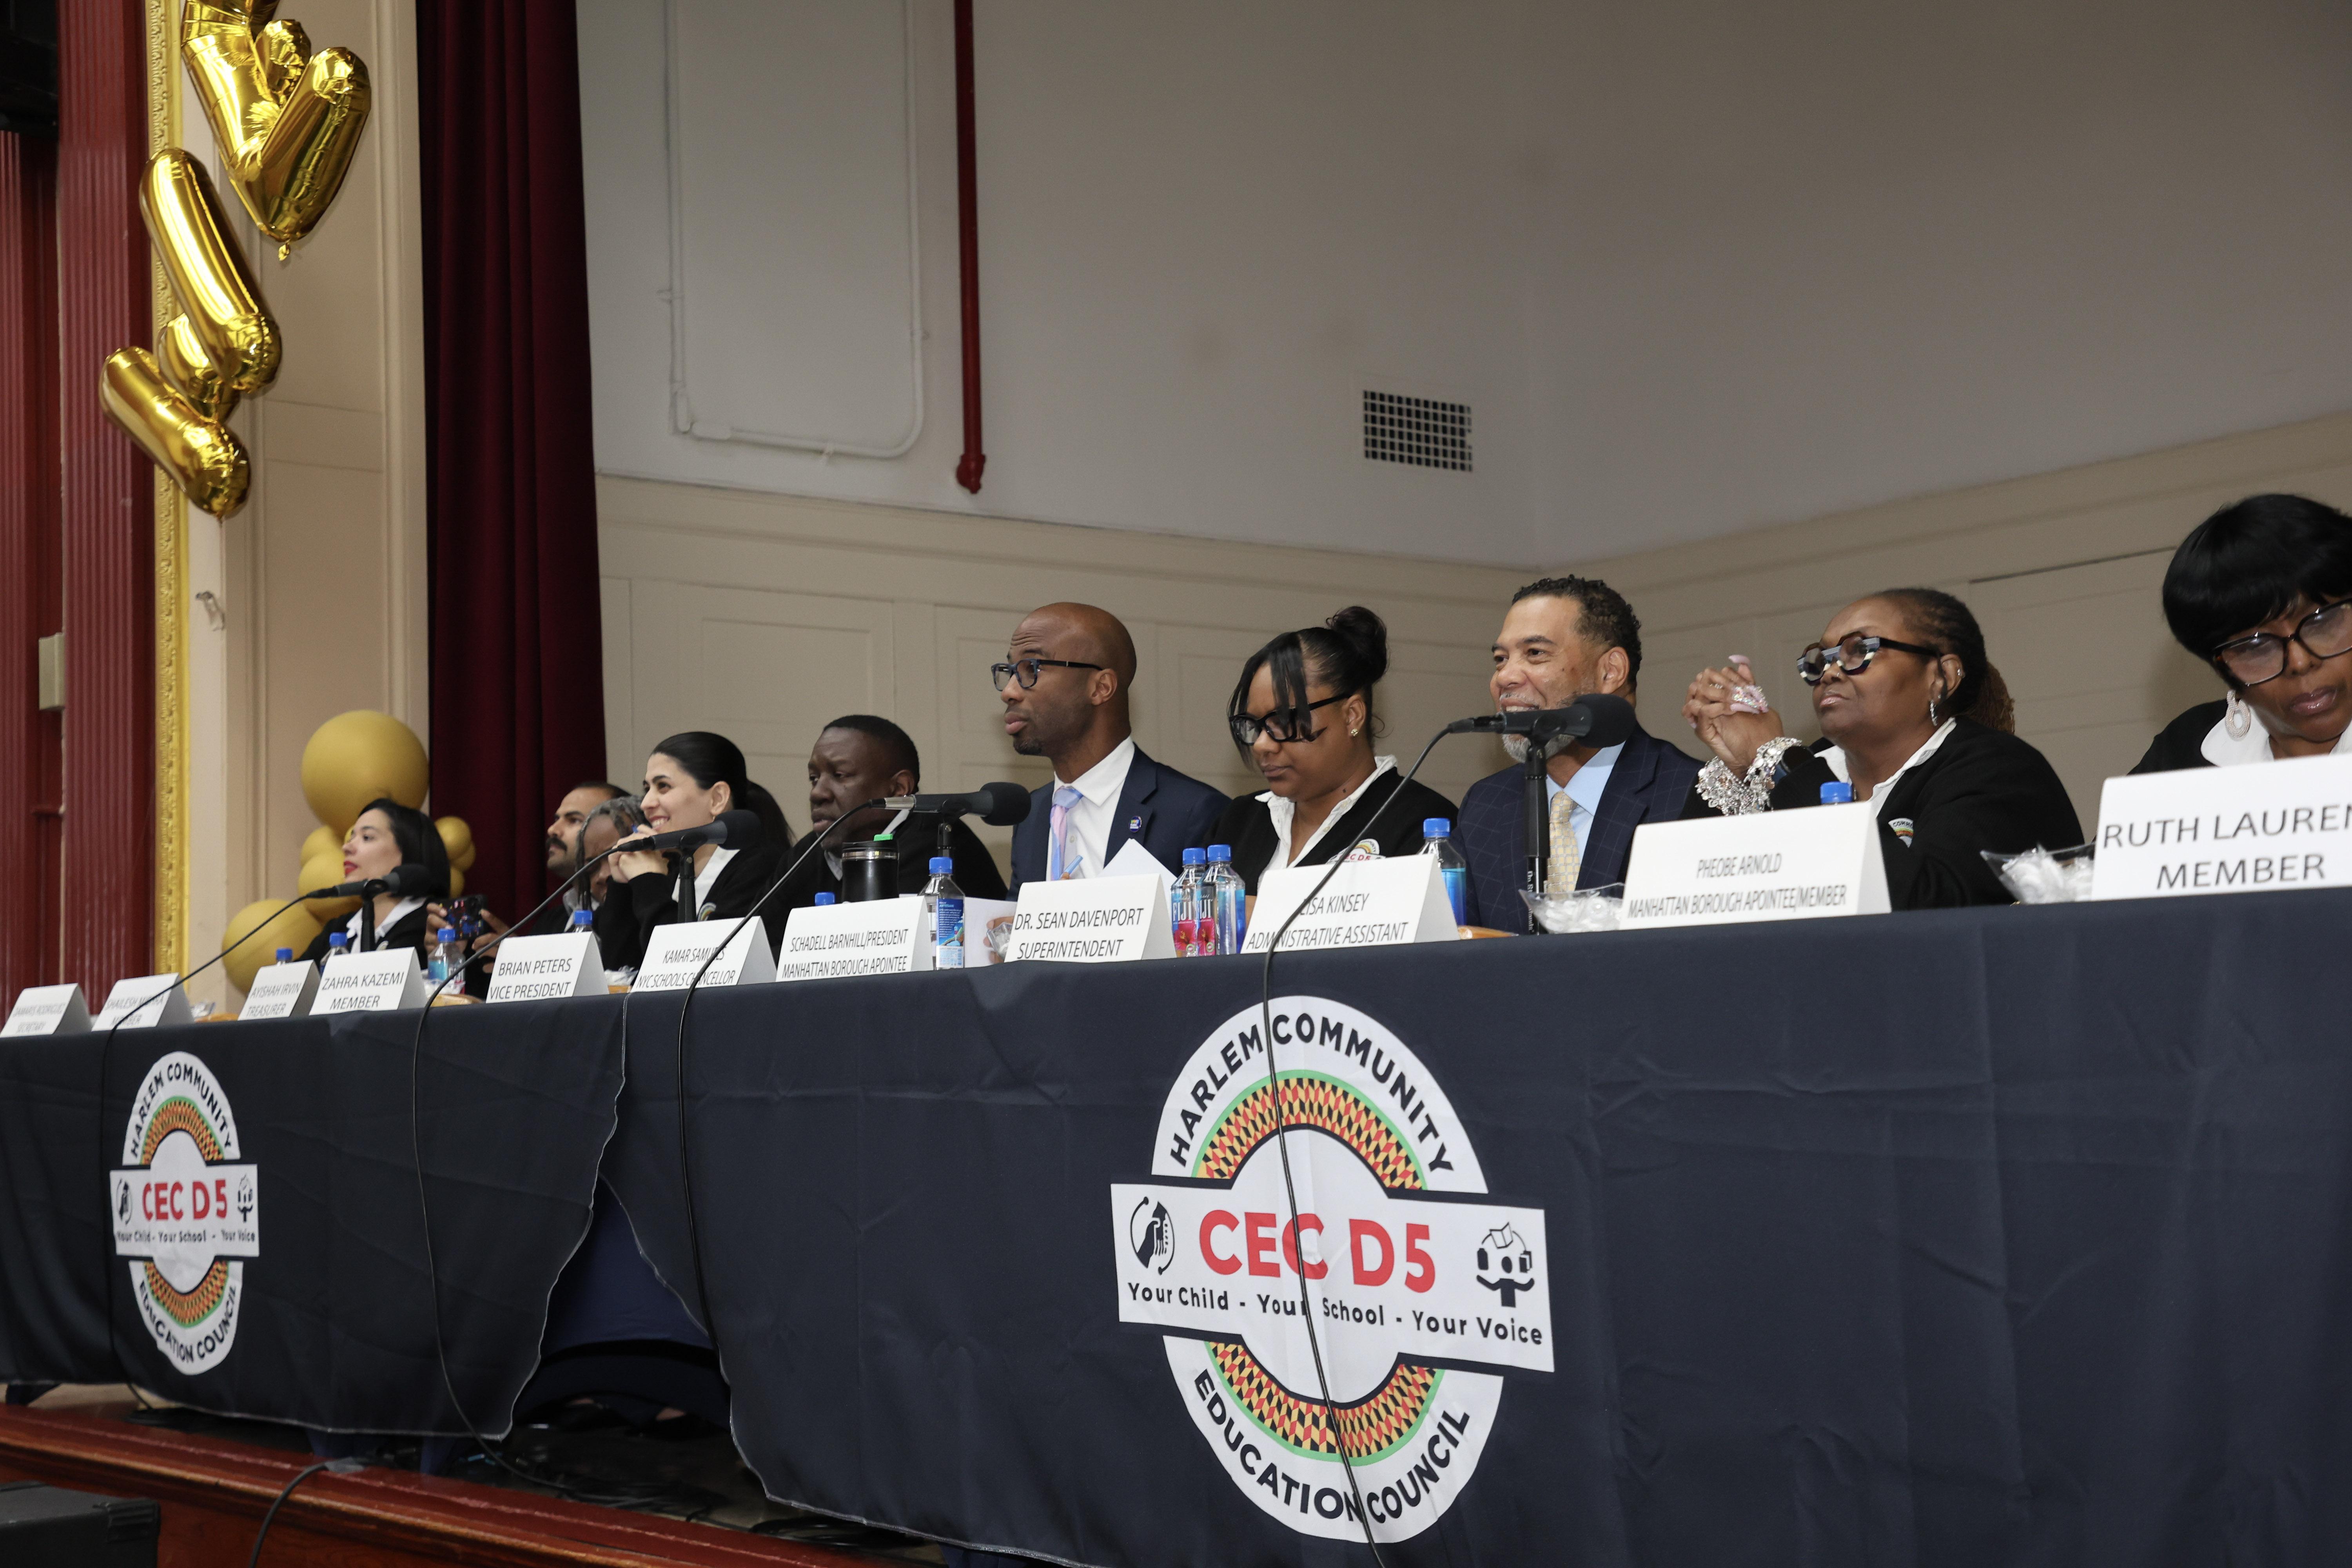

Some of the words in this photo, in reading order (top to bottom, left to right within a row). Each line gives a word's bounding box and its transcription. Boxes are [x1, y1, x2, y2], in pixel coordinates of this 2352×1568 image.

[2103, 817, 2200, 849] RUTH
[1697, 857, 1738, 878] PHEOBE
[1739, 853, 1782, 875] ARNOLD
[2156, 853, 2326, 890] MEMBER
[1326, 893, 1370, 915] KINSEY
[1628, 897, 1688, 918] MANHATTAN
[1691, 891, 1742, 914] BOROUGH
[1014, 914, 1033, 930] DR.
[1036, 912, 1068, 929] SEAN
[1069, 908, 1144, 928] DAVENPORT
[790, 935, 826, 952] SCHADELL
[1246, 926, 1343, 949] ADMNISTRATIVE
[1343, 922, 1408, 944] ASSISTANT
[663, 949, 691, 964] KAMAR
[1017, 940, 1123, 959] SUPERINTENDENT
[498, 961, 532, 976] BRIAN
[533, 958, 572, 974] PETERS
[782, 961, 830, 978] MANHATTAN
[831, 958, 869, 976] BOROUGH
[870, 956, 907, 973] APOINTEE
[321, 975, 358, 991] ZAHRA
[361, 971, 405, 987] KAZEMI
[636, 975, 653, 988] NYC
[651, 973, 687, 987] SCHOOLS
[686, 970, 736, 986] CHNCELLOR
[490, 985, 511, 999] VICE
[513, 982, 571, 998] PRESIDENT
[247, 1002, 287, 1016] TREASURER
[330, 995, 380, 1010] MEMBER
[1170, 1024, 1264, 1167] HARLEM
[1271, 1013, 1454, 1173] COMMUNITY
[131, 1071, 164, 1158] HARLEM
[167, 1062, 231, 1148] COMMUNITY
[142, 1181, 183, 1222] CEC
[158, 1230, 176, 1243] Your
[1199, 1209, 1328, 1281] CEC
[1349, 1218, 1436, 1293] D5
[1127, 1282, 1172, 1303] Your
[1178, 1287, 1229, 1311] Child
[1322, 1297, 1384, 1326] School
[1412, 1310, 1466, 1336] Your
[1476, 1317, 1543, 1345] Voice
[1194, 1368, 1367, 1524] EDUCATION
[1367, 1410, 1470, 1524] COUNCIL
